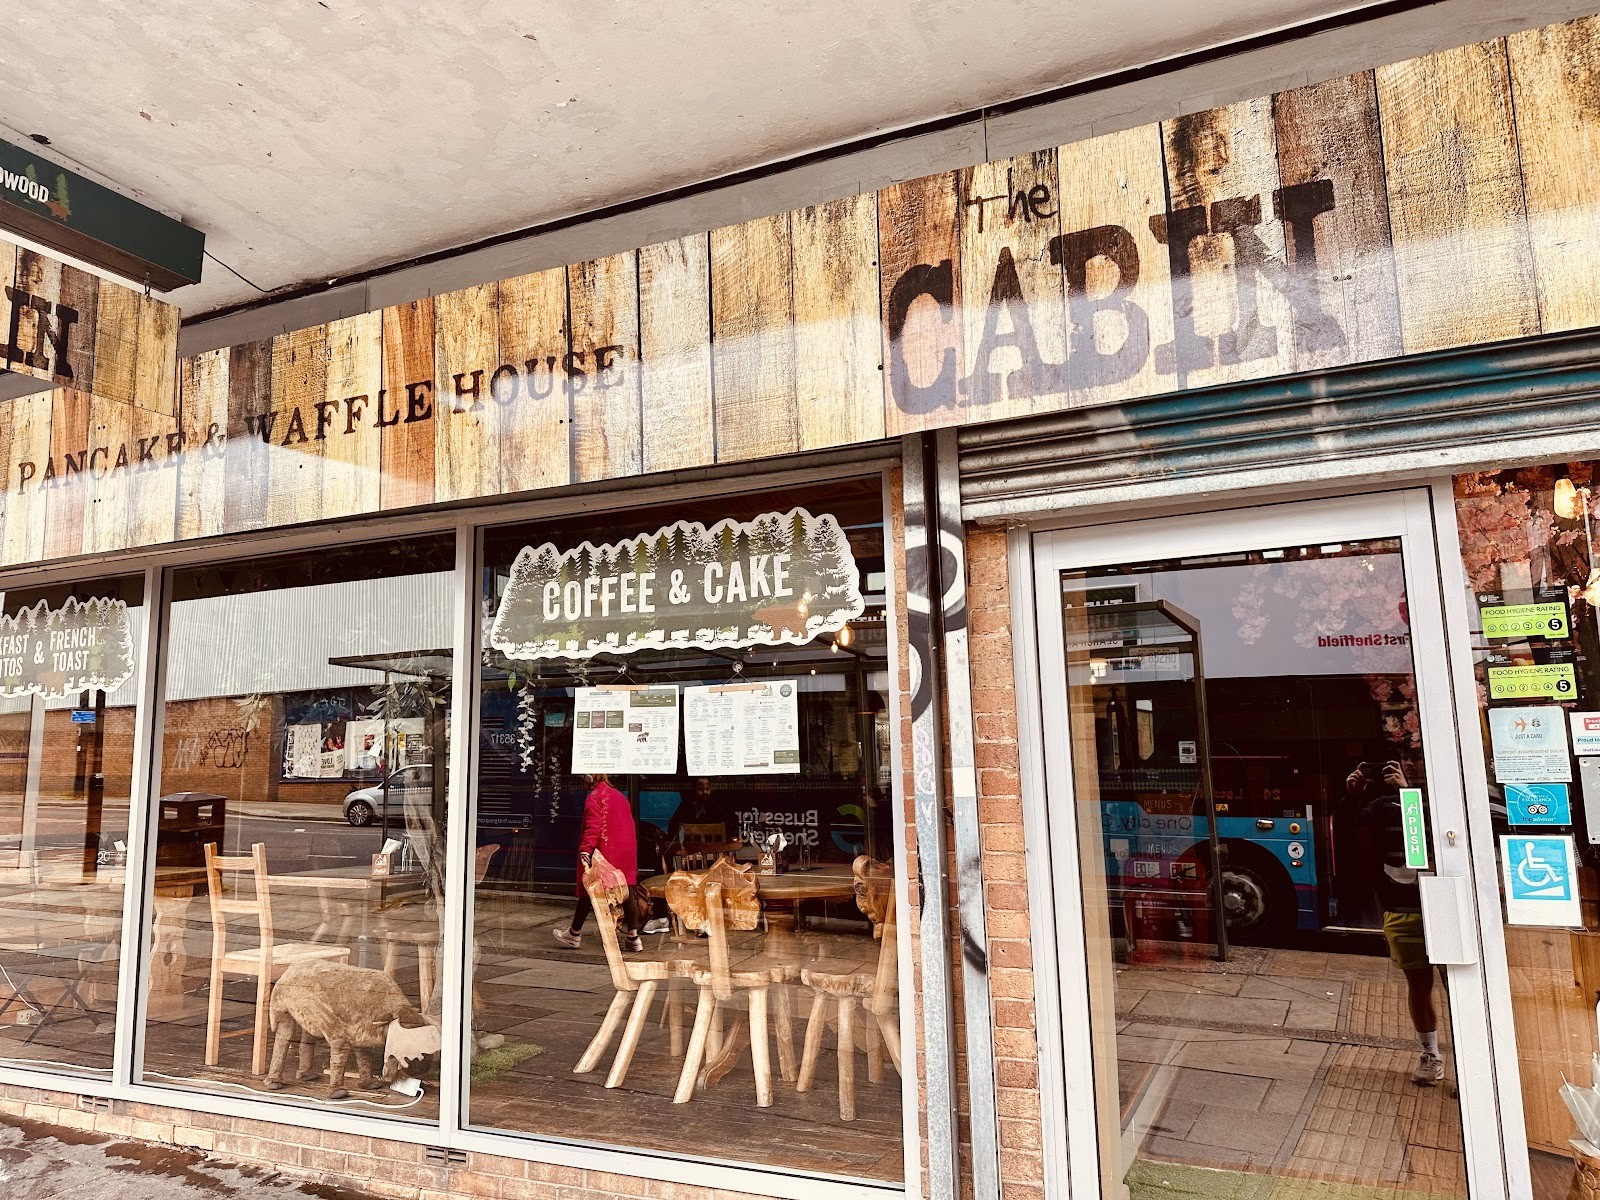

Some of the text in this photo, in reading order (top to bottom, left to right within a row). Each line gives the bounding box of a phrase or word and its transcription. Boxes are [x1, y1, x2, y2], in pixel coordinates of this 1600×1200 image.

[888, 178, 1347, 416] CABIN
[18, 344, 624, 495] PANCAKE & WAFFLE HOUSE
[542, 554, 794, 622] COFFEE & CAKE
[1506, 607, 1536, 615] HYGIENE
[1551, 620, 1560, 630] 5
[33, 640, 45, 664] &
[49, 627, 97, 651] FRENCH
[52, 650, 90, 673] TOAST
[1559, 681, 1568, 691] 5
[1148, 843, 1179, 855] MENUS
[1408, 816, 1420, 854] PUSH
